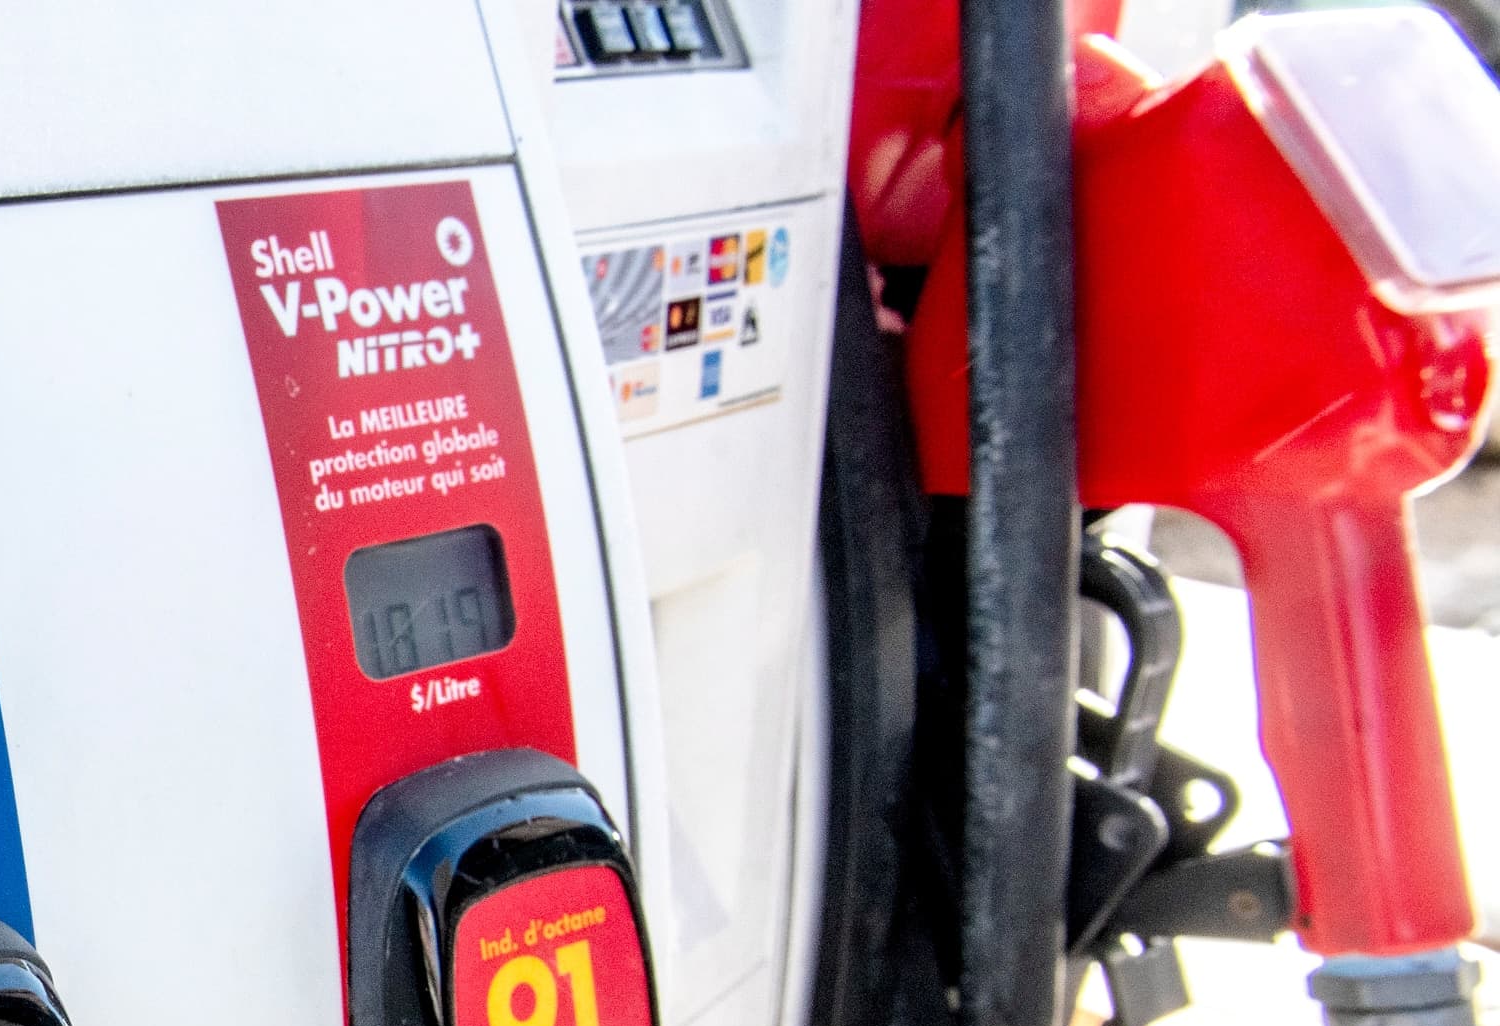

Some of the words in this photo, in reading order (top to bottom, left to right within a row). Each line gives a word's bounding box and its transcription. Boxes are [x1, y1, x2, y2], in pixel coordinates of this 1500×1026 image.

[251, 230, 334, 278] Shell
[260, 277, 469, 337] V-Power
[328, 416, 355, 439] La
[360, 395, 468, 434] MEILLEURE
[310, 440, 416, 485] protection
[422, 423, 498, 464] globale
[315, 484, 343, 511] du
[350, 477, 424, 504] moteur
[431, 461, 464, 495] qui
[470, 454, 505, 482] soit
[411, 678, 479, 712] $/Litre
[480, 928, 518, 960] Ind.
[524, 907, 605, 946] d'octane
